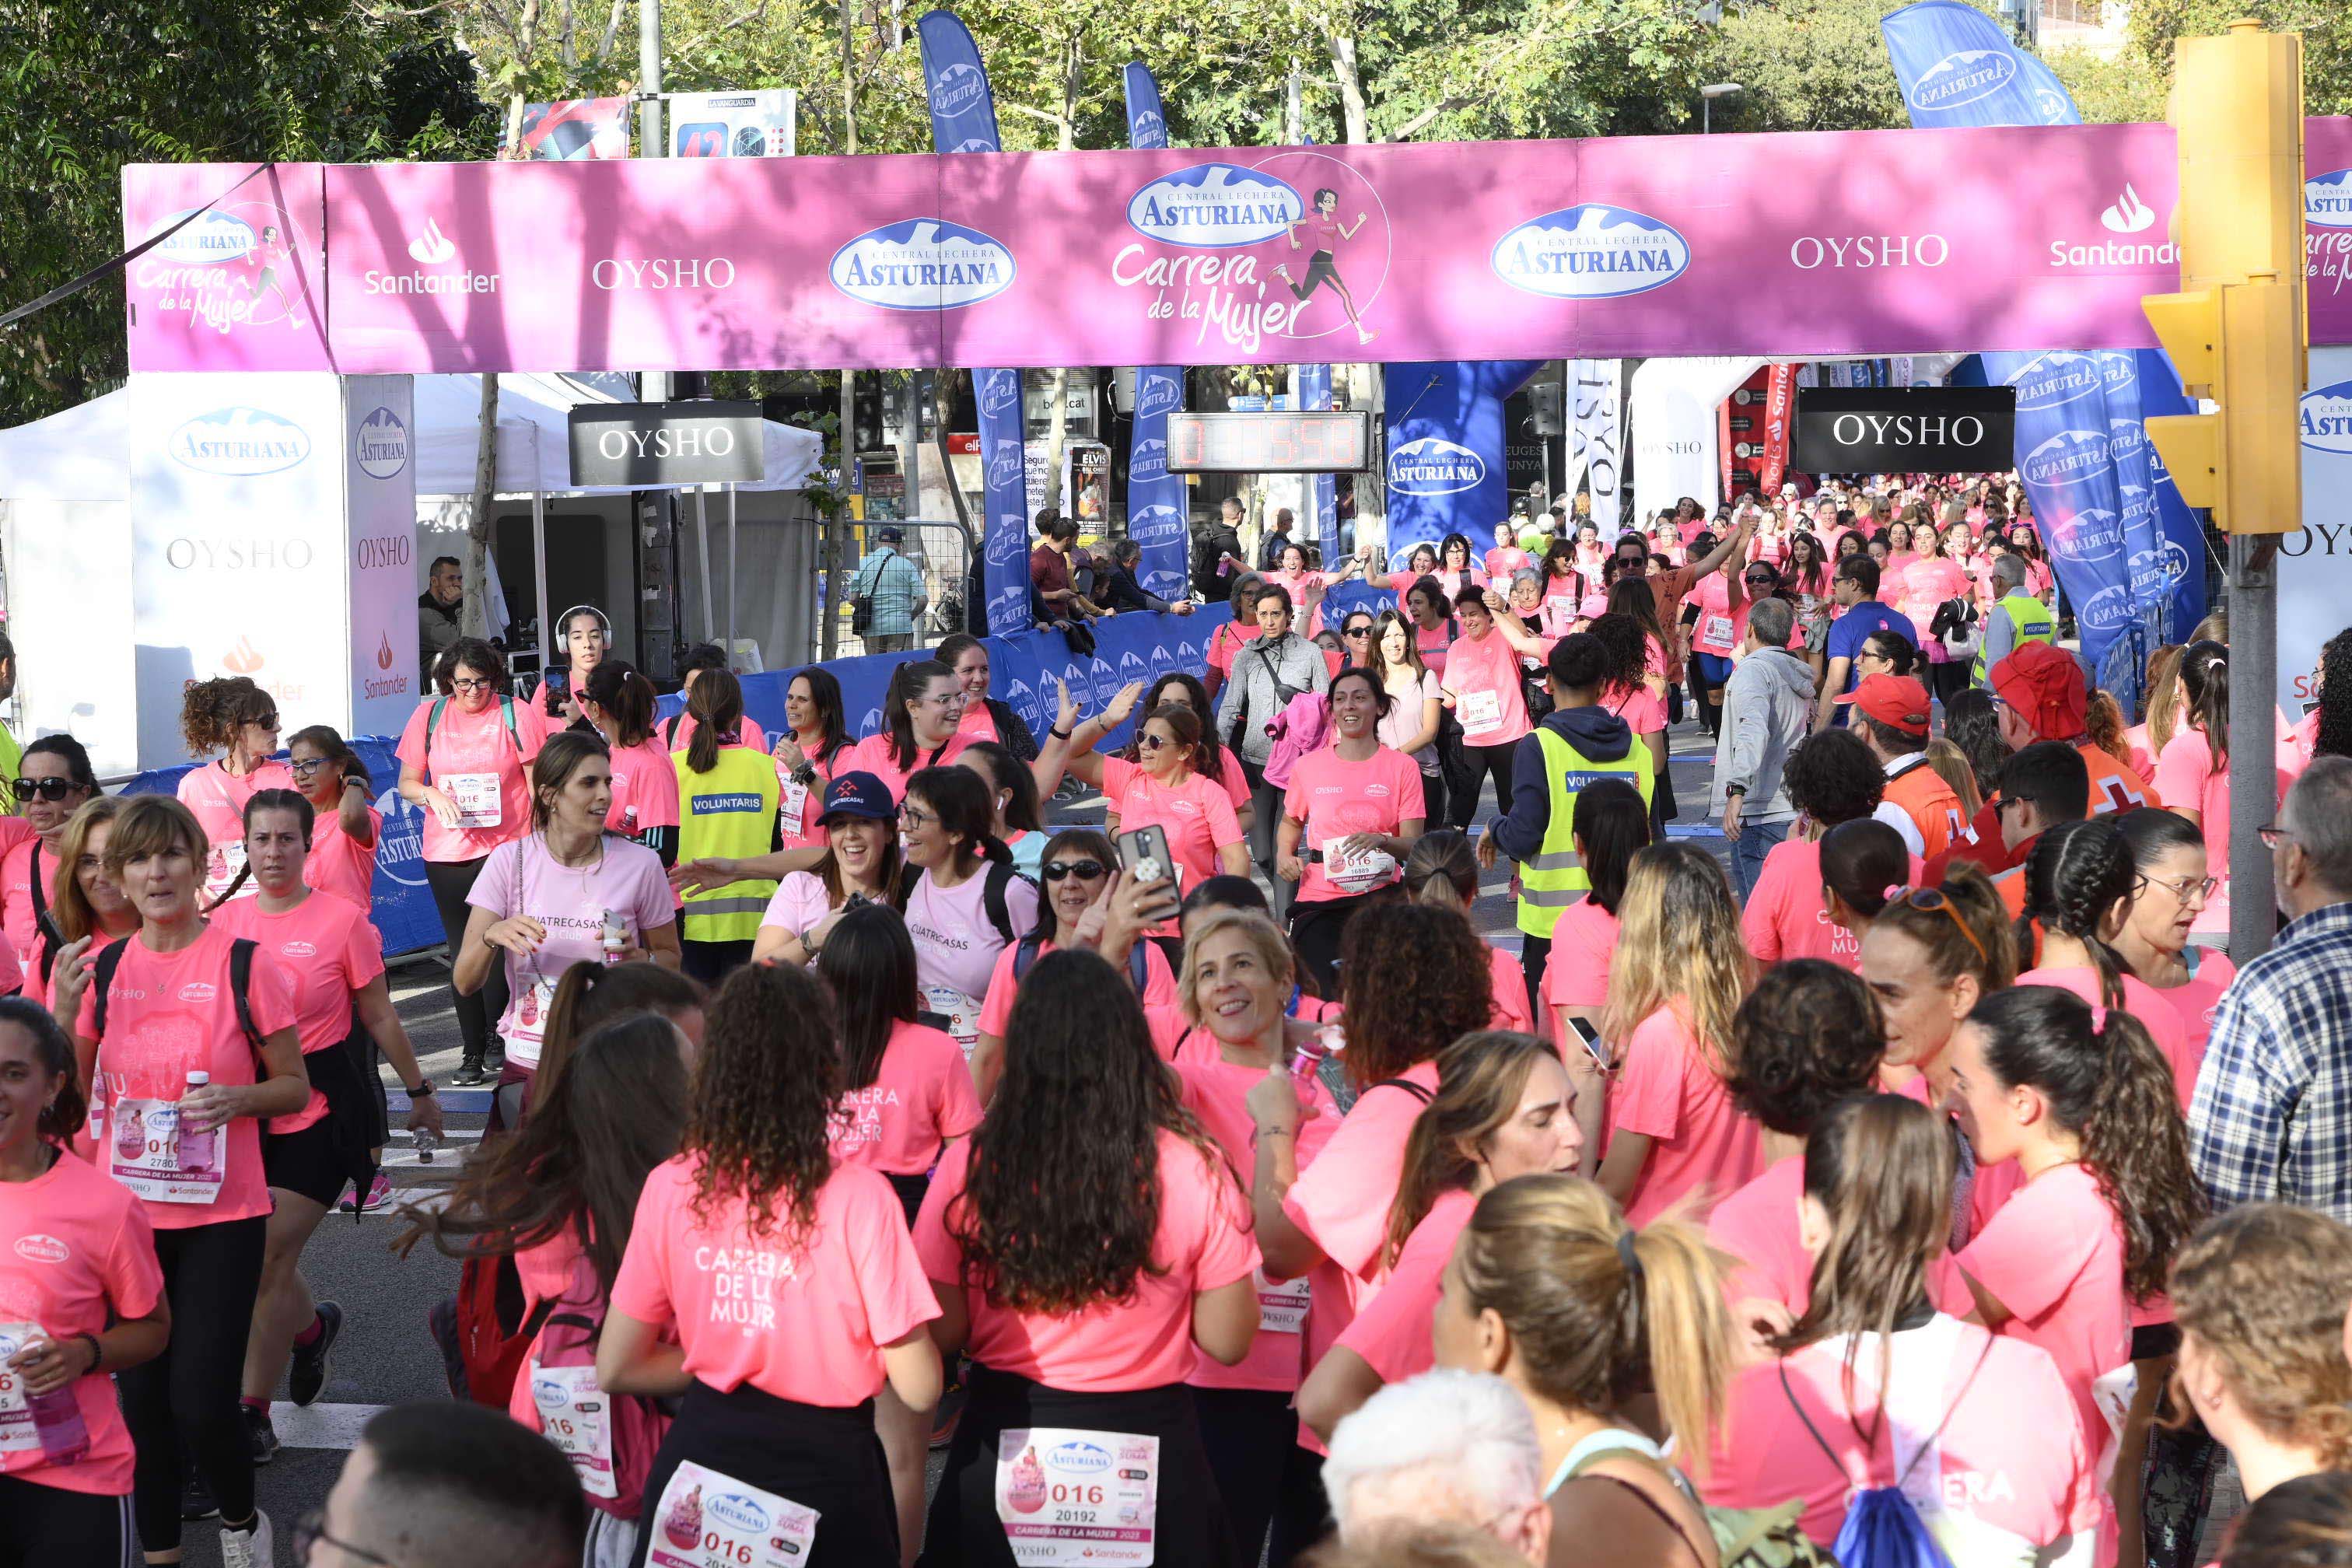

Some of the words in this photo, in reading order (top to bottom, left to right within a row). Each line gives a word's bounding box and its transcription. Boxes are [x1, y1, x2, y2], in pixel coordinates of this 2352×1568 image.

[1167, 192, 1223, 201] CENTRAL
[1229, 191, 1285, 200] LECHERA
[1140, 195, 1289, 226] ASTURIANA
[873, 249, 932, 260] CENTRAL
[936, 247, 996, 258] LECHERA
[1537, 236, 1600, 247] CENTRAL
[1605, 234, 1668, 246] LECHERA
[1791, 234, 1949, 269] OYSHO
[2050, 240, 2180, 267] Santand
[2306, 233, 2352, 255] arre
[844, 254, 1001, 286] ASTURIANA
[1111, 243, 1255, 287] Carrera
[1508, 241, 1675, 274] ASTURIANA
[136, 261, 227, 289] Carrera
[365, 269, 499, 296] Santander
[593, 257, 734, 289] OYSHO
[159, 290, 174, 310] de
[180, 292, 191, 310] la
[1148, 288, 1174, 320] de
[1181, 289, 1200, 320] la
[1196, 281, 1311, 354] Mujer
[599, 426, 734, 459] OYSHO
[1833, 415, 1984, 446] OYSHO
[182, 432, 299, 460] ASTURIANA
[360, 436, 405, 461] ASTURIANA
[1082, 454, 1106, 464] ELVIS
[1025, 478, 1048, 490] quiere
[1391, 461, 1478, 482] ASTURIANA
[166, 538, 314, 569] OYSHO
[359, 534, 410, 569] OYSHO
[365, 675, 408, 699] Santander
[693, 798, 760, 810] VOLUNTARIS
[858, 1105, 880, 1122] LA
[716, 1273, 744, 1300] DE
[1297, 1283, 1310, 1294] 24
[1053, 1453, 1108, 1467] ASTURIANA
[1052, 1484, 1104, 1504] 016
[713, 1499, 764, 1529] ASTURIANA
[1055, 1510, 1096, 1523] 20192
[1014, 1527, 1056, 1535] CARRERA
[1087, 1530, 1116, 1538] MUJER
[705, 1531, 753, 1564] 016
[1095, 1548, 1143, 1559] Santander
